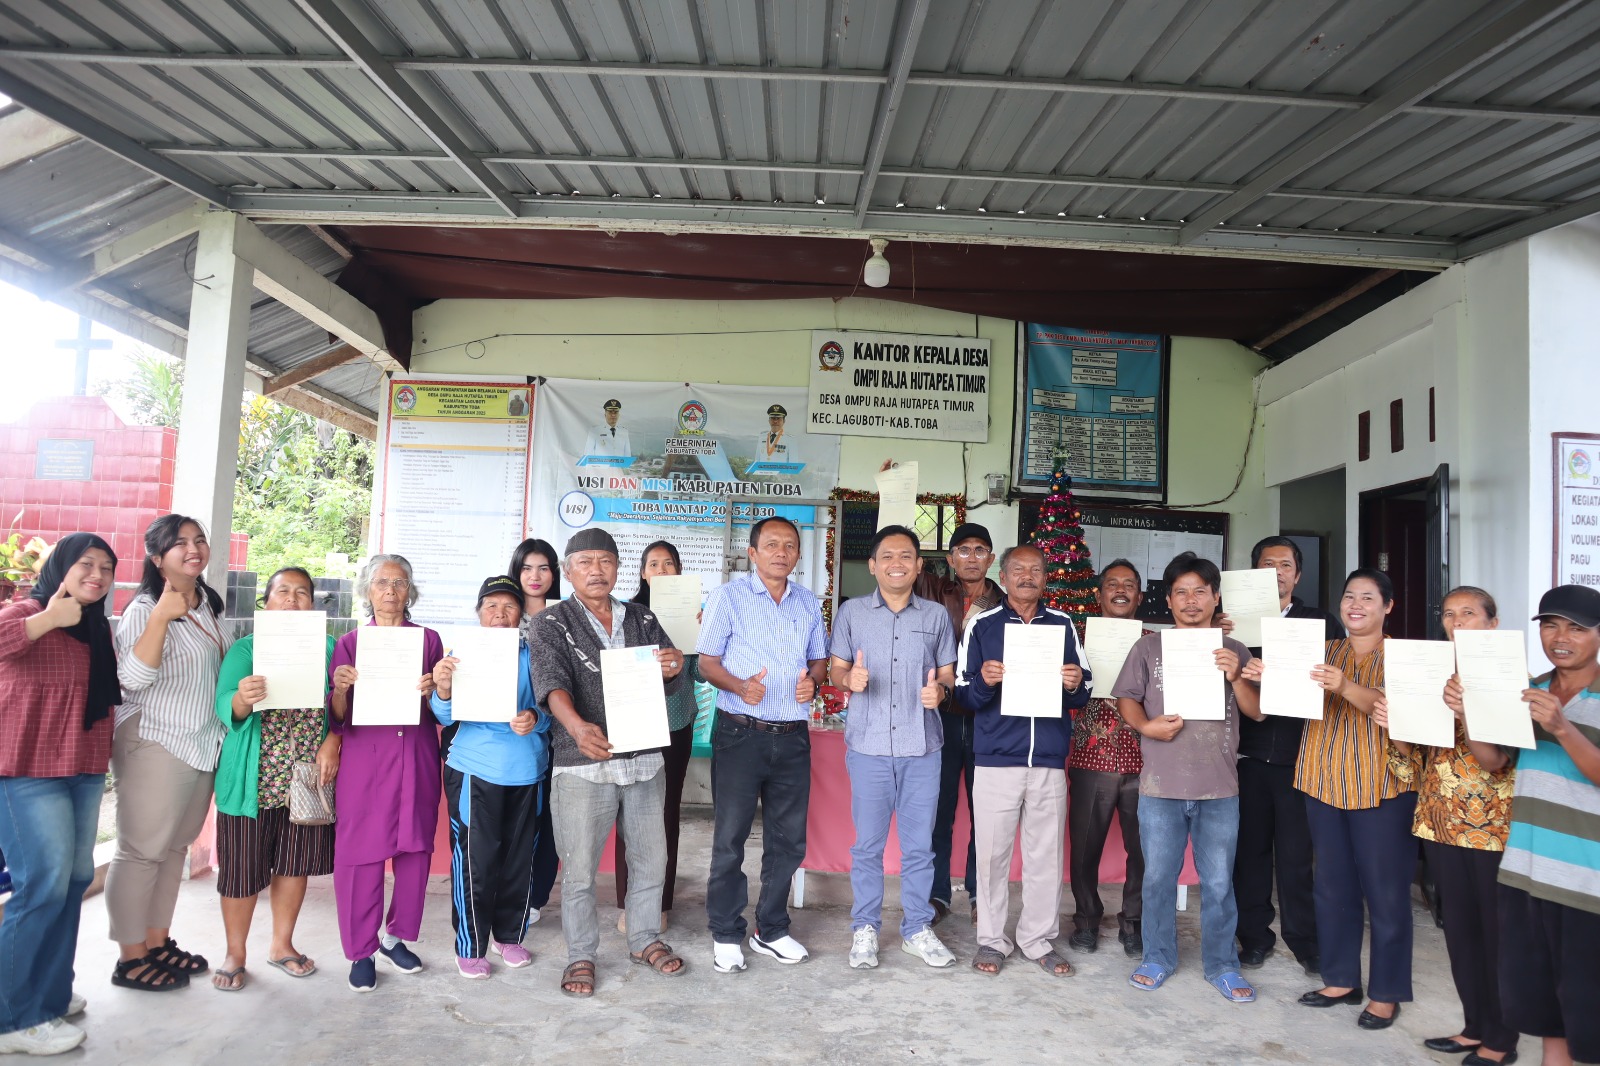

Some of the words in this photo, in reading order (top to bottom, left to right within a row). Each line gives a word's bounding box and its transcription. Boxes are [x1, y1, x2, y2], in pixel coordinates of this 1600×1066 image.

[854, 342, 910, 362] KANTOR
[914, 346, 960, 366] KEPALA
[962, 348, 988, 367] DESA
[854, 368, 879, 388] OMPU
[882, 370, 908, 390] RAJA
[910, 372, 954, 392] HUTAPEA
[956, 374, 986, 394] TIMUR
[820, 394, 841, 405] DESA
[844, 395, 870, 407] OMPU
[874, 397, 898, 408] RAJA
[900, 398, 939, 411] HUTAPEA
[943, 400, 975, 412] TIMUR
[665, 439, 717, 448] PEMERINTAH
[578, 476, 604, 488] VISI
[609, 478, 637, 490] DAN
[642, 478, 673, 491] MISI
[678, 480, 760, 495] KABUPATEN
[765, 483, 802, 496] TOBA
[565, 504, 587, 514] VISI
[632, 502, 660, 513] TOBA
[664, 504, 708, 515] MANTAP
[711, 505, 775, 516] 205-2030
[1572, 514, 1598, 526] LOKASI
[1571, 534, 1600, 546] VOLUME
[1570, 554, 1590, 565] PAGU
